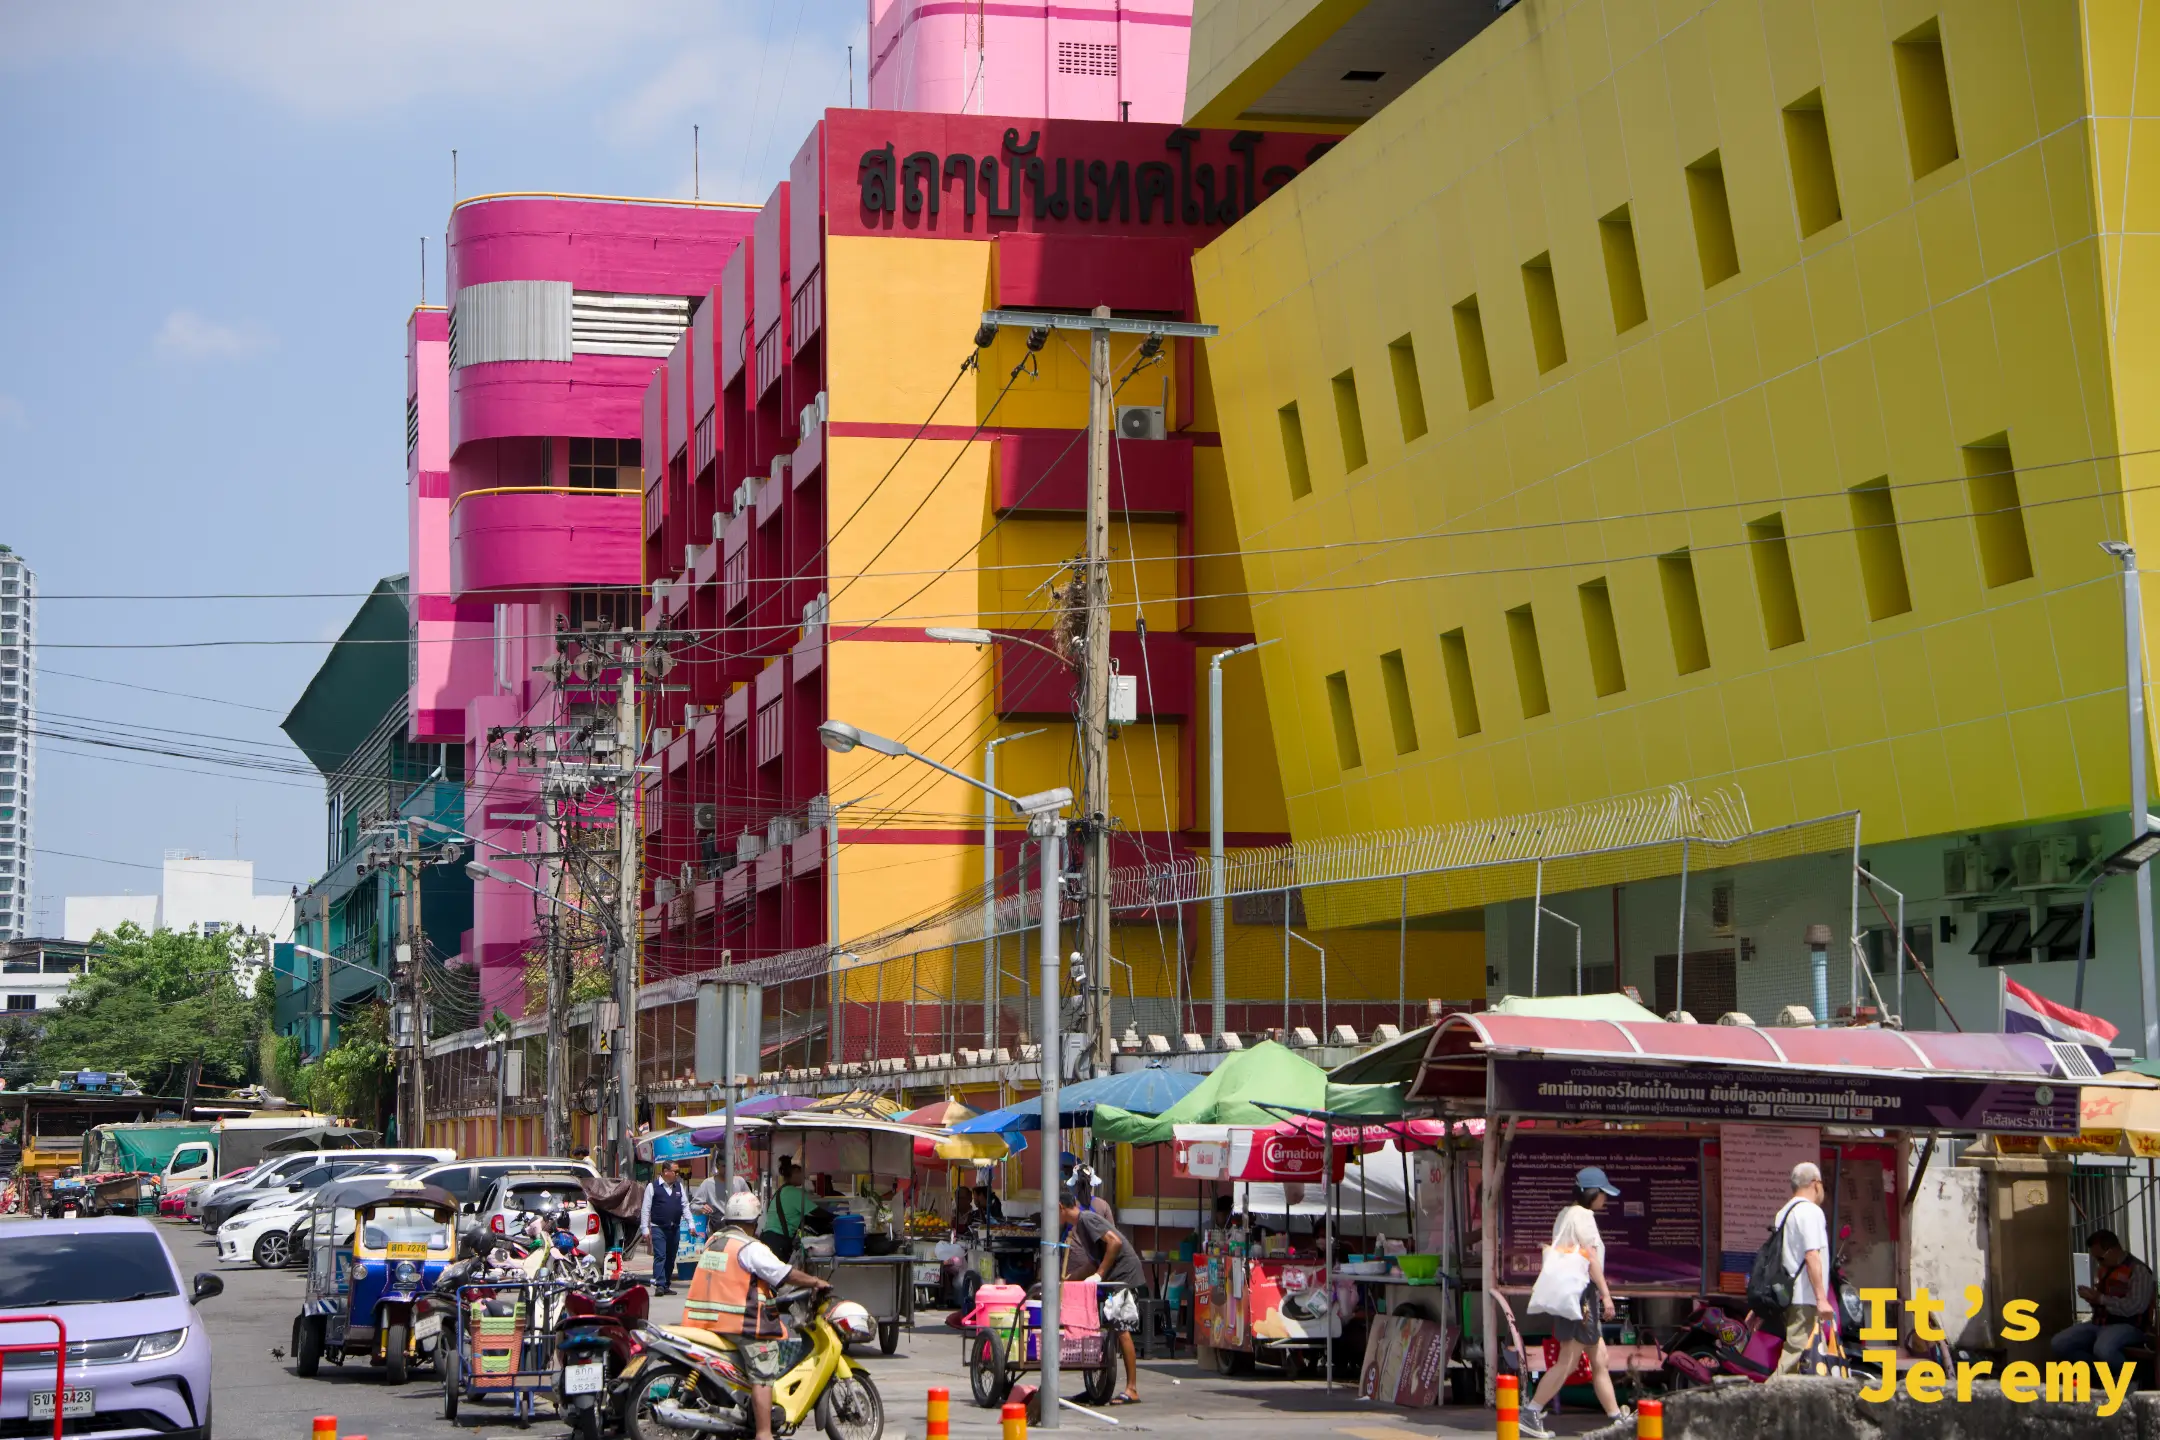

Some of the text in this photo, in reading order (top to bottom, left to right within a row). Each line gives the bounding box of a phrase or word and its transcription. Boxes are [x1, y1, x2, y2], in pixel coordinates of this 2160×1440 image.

[1267, 1142, 1324, 1163] Carnation
[1430, 1168, 1442, 1184] 50
[408, 1244, 426, 1252] 7278
[572, 1382, 597, 1392] 3525
[62, 1391, 91, 1404] 9423
